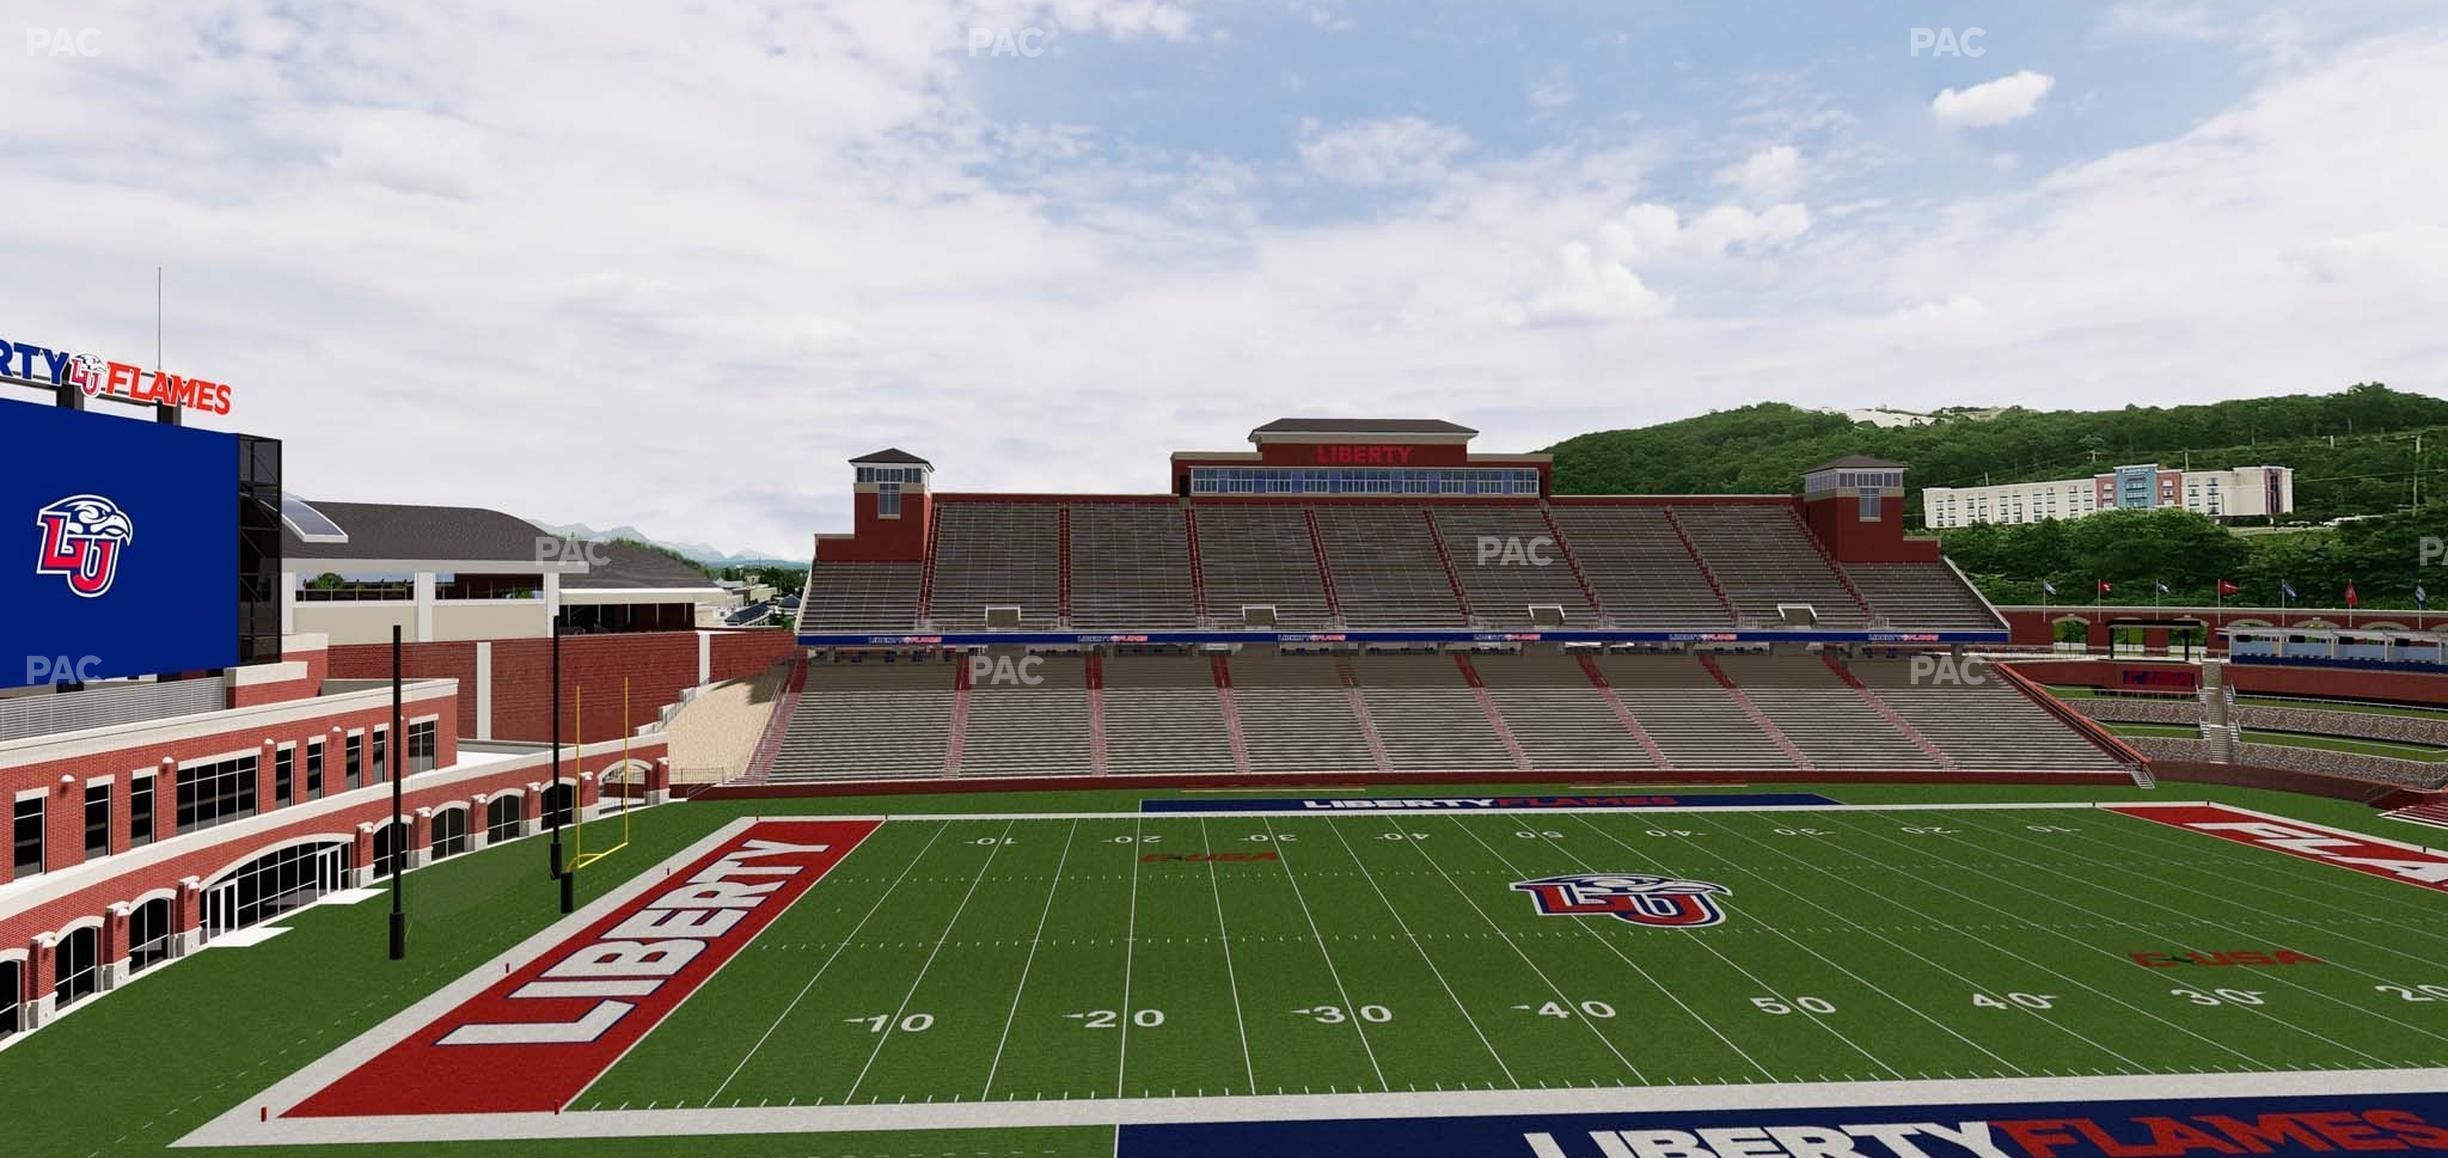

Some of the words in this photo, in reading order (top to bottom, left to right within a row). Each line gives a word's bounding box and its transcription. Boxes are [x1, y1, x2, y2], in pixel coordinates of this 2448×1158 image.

[106, 360, 232, 415] FLAMES
[1316, 446, 1413, 464] LIBERTY
[37, 511, 122, 597] LU
[1302, 798, 1497, 809] LIBERTY
[1497, 796, 1680, 807] FLAMES
[434, 839, 832, 1046] LIBERTY
[1749, 996, 1837, 1015] 50
[1973, 992, 2053, 1010] 40
[2170, 987, 2264, 1006] 30
[1085, 1009, 1165, 1028] 20
[1313, 1004, 1393, 1024] 30
[1538, 1000, 1617, 1018] 40
[864, 1013, 934, 1032] 10
[1990, 1108, 2448, 1158] FLAMES
